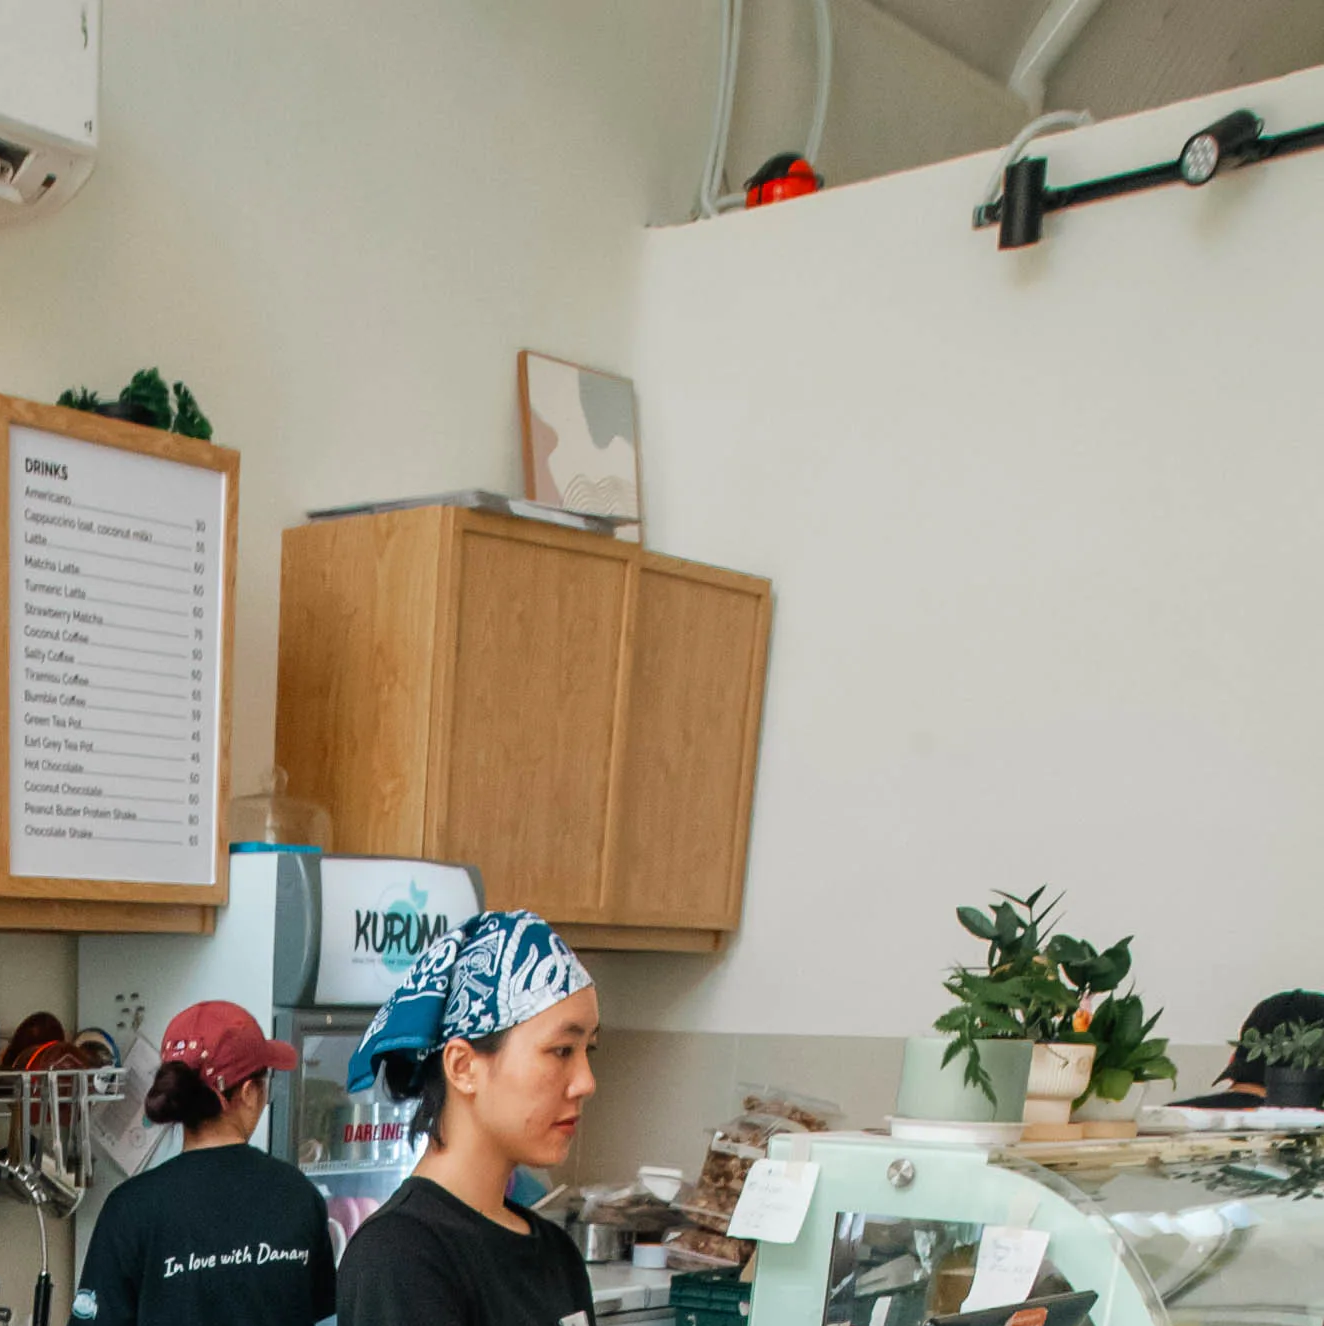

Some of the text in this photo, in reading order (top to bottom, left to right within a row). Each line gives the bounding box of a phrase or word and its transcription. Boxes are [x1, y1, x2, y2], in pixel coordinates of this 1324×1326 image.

[25, 457, 68, 480] DRINKS
[354, 909, 448, 955] KURUMI
[344, 1123, 404, 1143] DARLING
[164, 1257, 184, 1278] In
[188, 1253, 216, 1271] love
[220, 1245, 252, 1265] with
